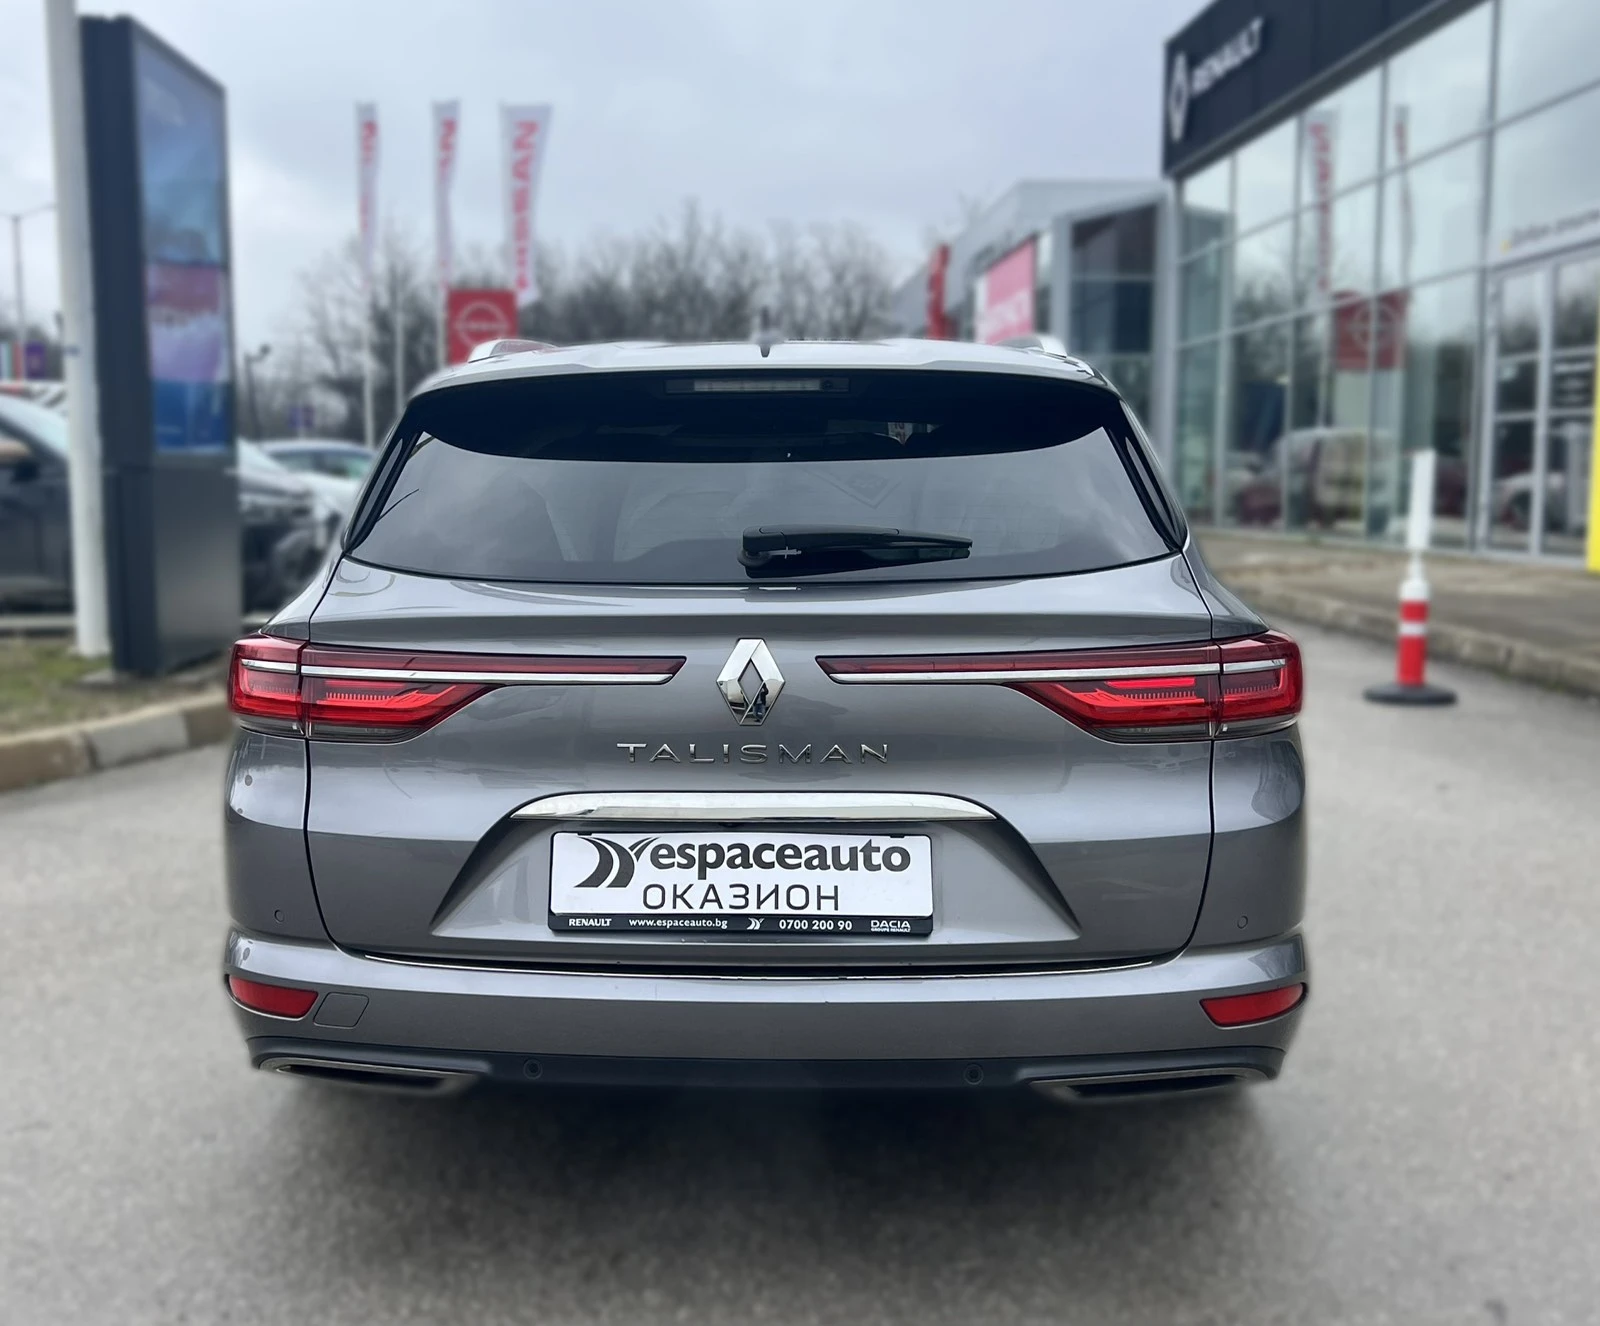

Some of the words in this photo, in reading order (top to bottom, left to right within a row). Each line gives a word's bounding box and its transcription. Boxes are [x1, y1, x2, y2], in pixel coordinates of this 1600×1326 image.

[616, 743, 890, 764] TALISMAN
[649, 838, 912, 880] espaceauto
[642, 883, 840, 911] ОКАЗИОН
[568, 918, 612, 926] RENAULT
[628, 917, 728, 930] www.espaceauto.bg
[779, 919, 809, 930] 0700
[812, 920, 835, 930] 200
[837, 920, 853, 931] 90
[870, 920, 911, 928] DACIA
